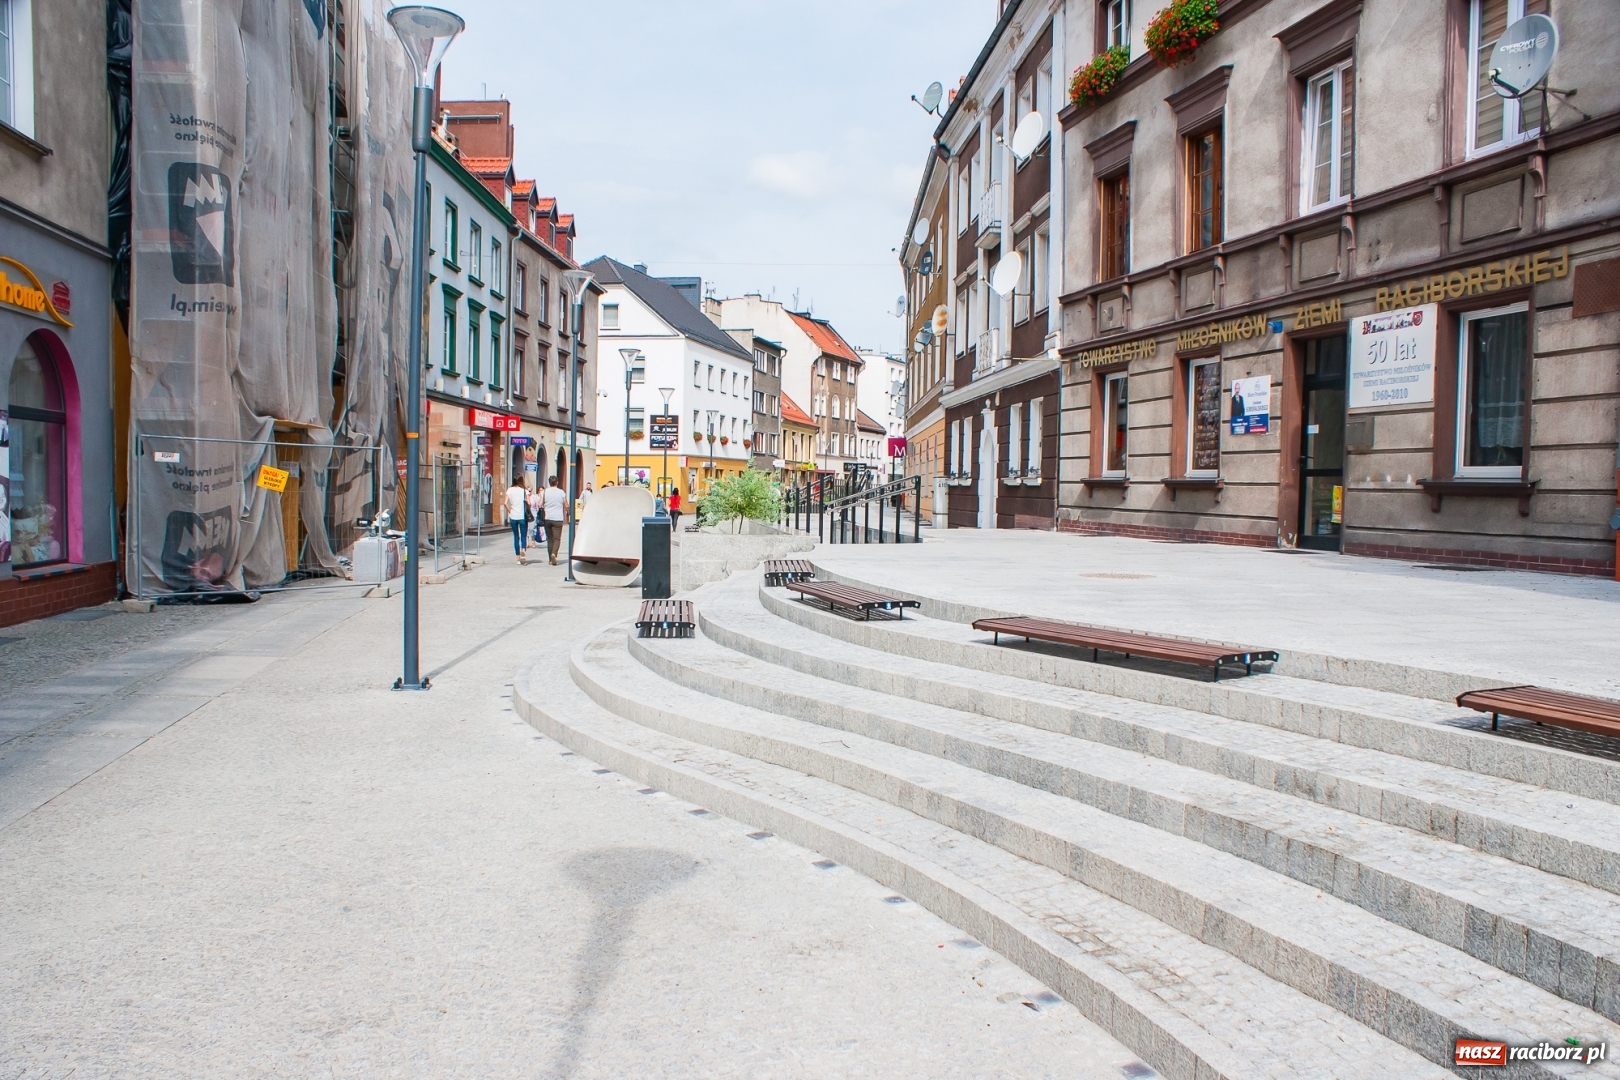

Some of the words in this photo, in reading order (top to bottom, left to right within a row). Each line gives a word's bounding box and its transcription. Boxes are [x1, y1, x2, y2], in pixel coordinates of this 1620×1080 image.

[1500, 38, 1536, 52] CYFROWY
[1078, 338, 1157, 369] TOWARZYSTWO
[1176, 313, 1268, 351] MIŁOŚNIKÓW
[1292, 298, 1342, 331] ZIEMI
[1375, 246, 1569, 313] RACIBORSKIEJ
[1367, 337, 1388, 365] 50
[1394, 335, 1417, 361] lat
[1352, 368, 1393, 380] TOWARZYSTWO
[1380, 375, 1420, 386] RACIBORSKIEJ
[1371, 387, 1409, 401] 1960-2010
